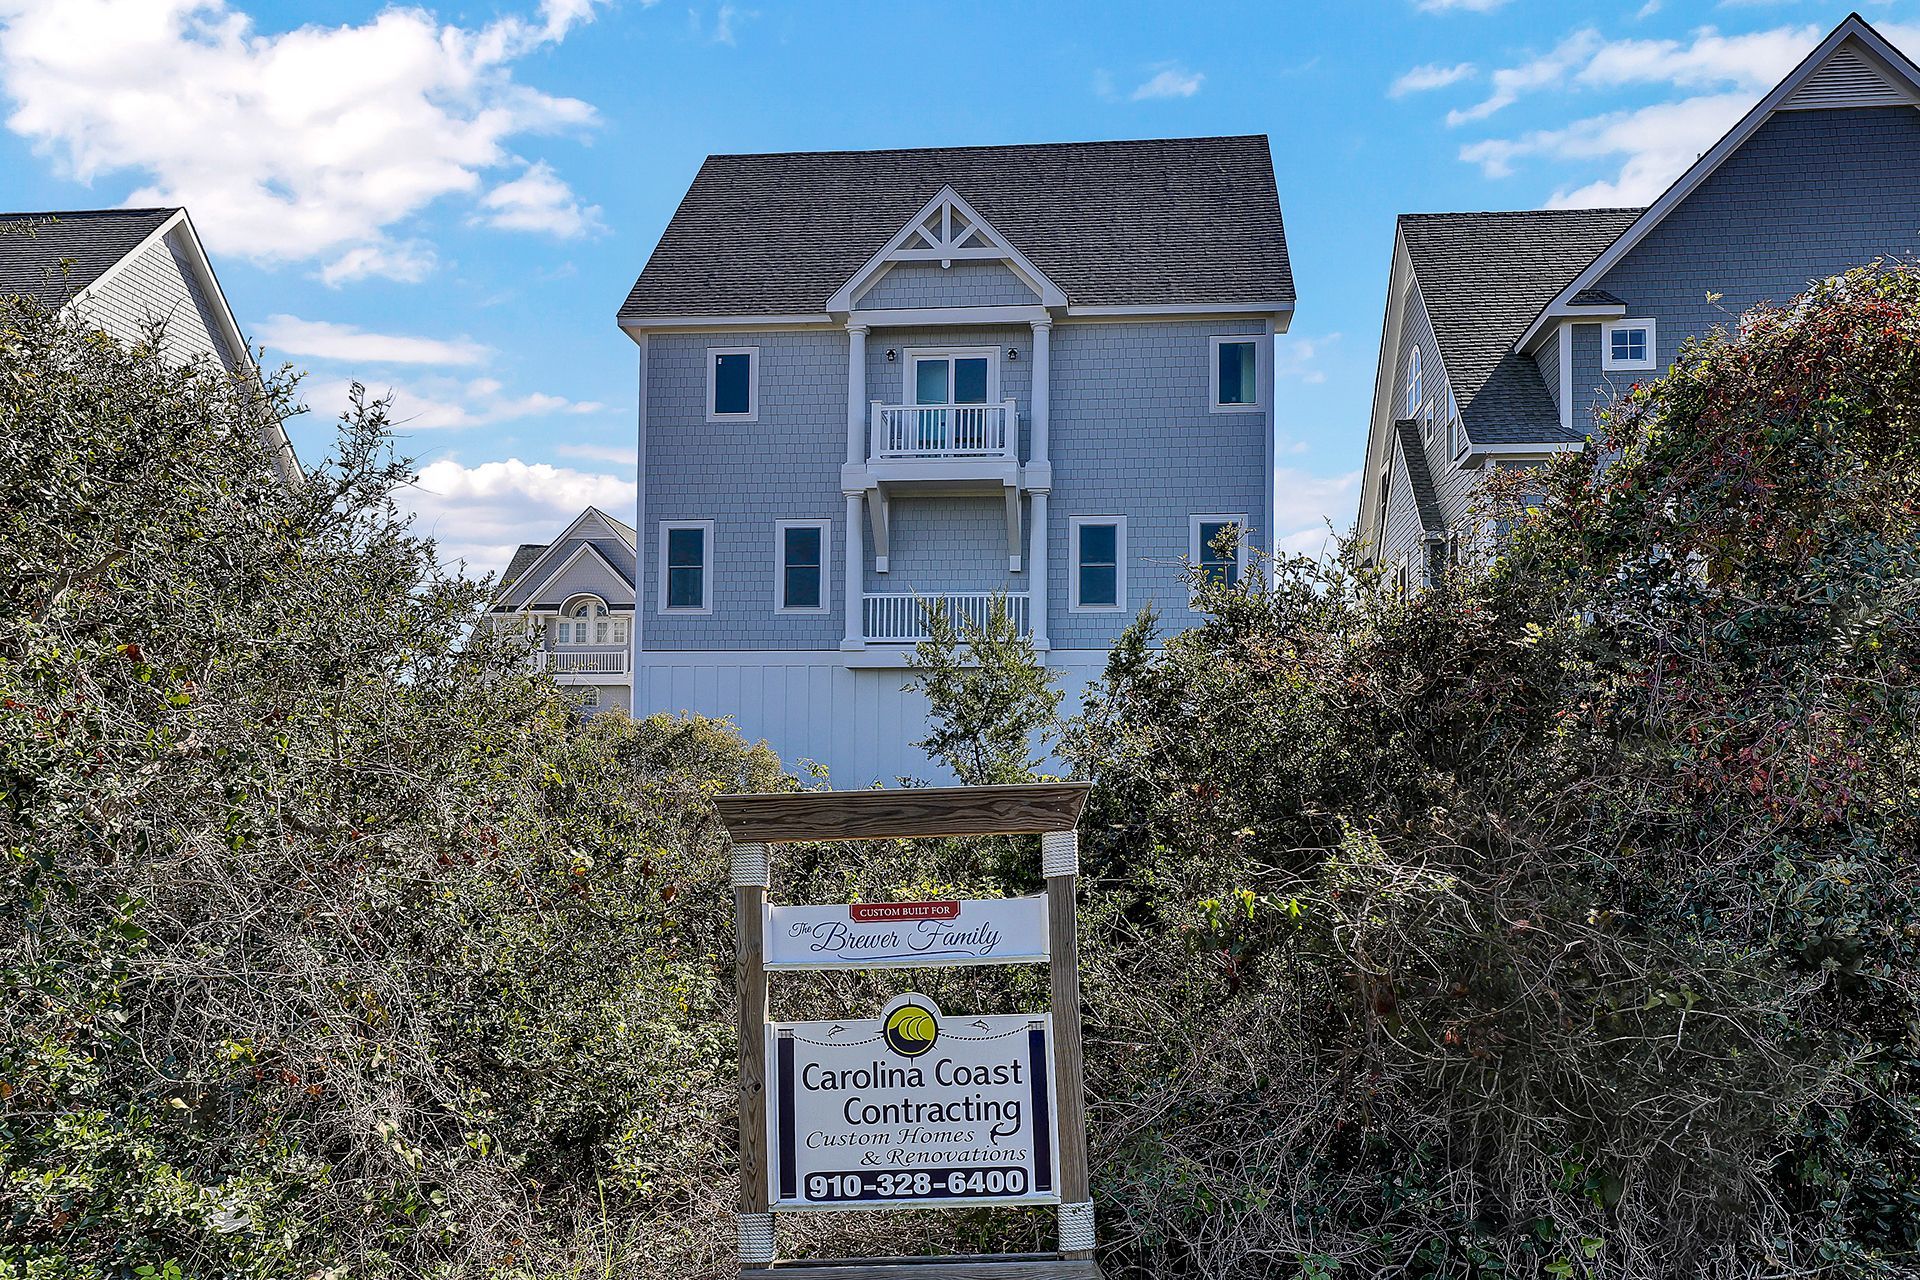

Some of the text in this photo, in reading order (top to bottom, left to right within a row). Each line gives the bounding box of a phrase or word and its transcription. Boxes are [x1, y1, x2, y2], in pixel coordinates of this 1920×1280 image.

[859, 905, 951, 918] CUSTOM BUILT FOR
[788, 919, 1002, 955] The Brewer Family
[802, 1058, 1023, 1091] Carolina Coast
[843, 1093, 1022, 1145] Contracting
[806, 1126, 975, 1149] Custom Homes
[860, 1145, 1027, 1168] & Renovations
[809, 1170, 1025, 1199] 910-328-6400
